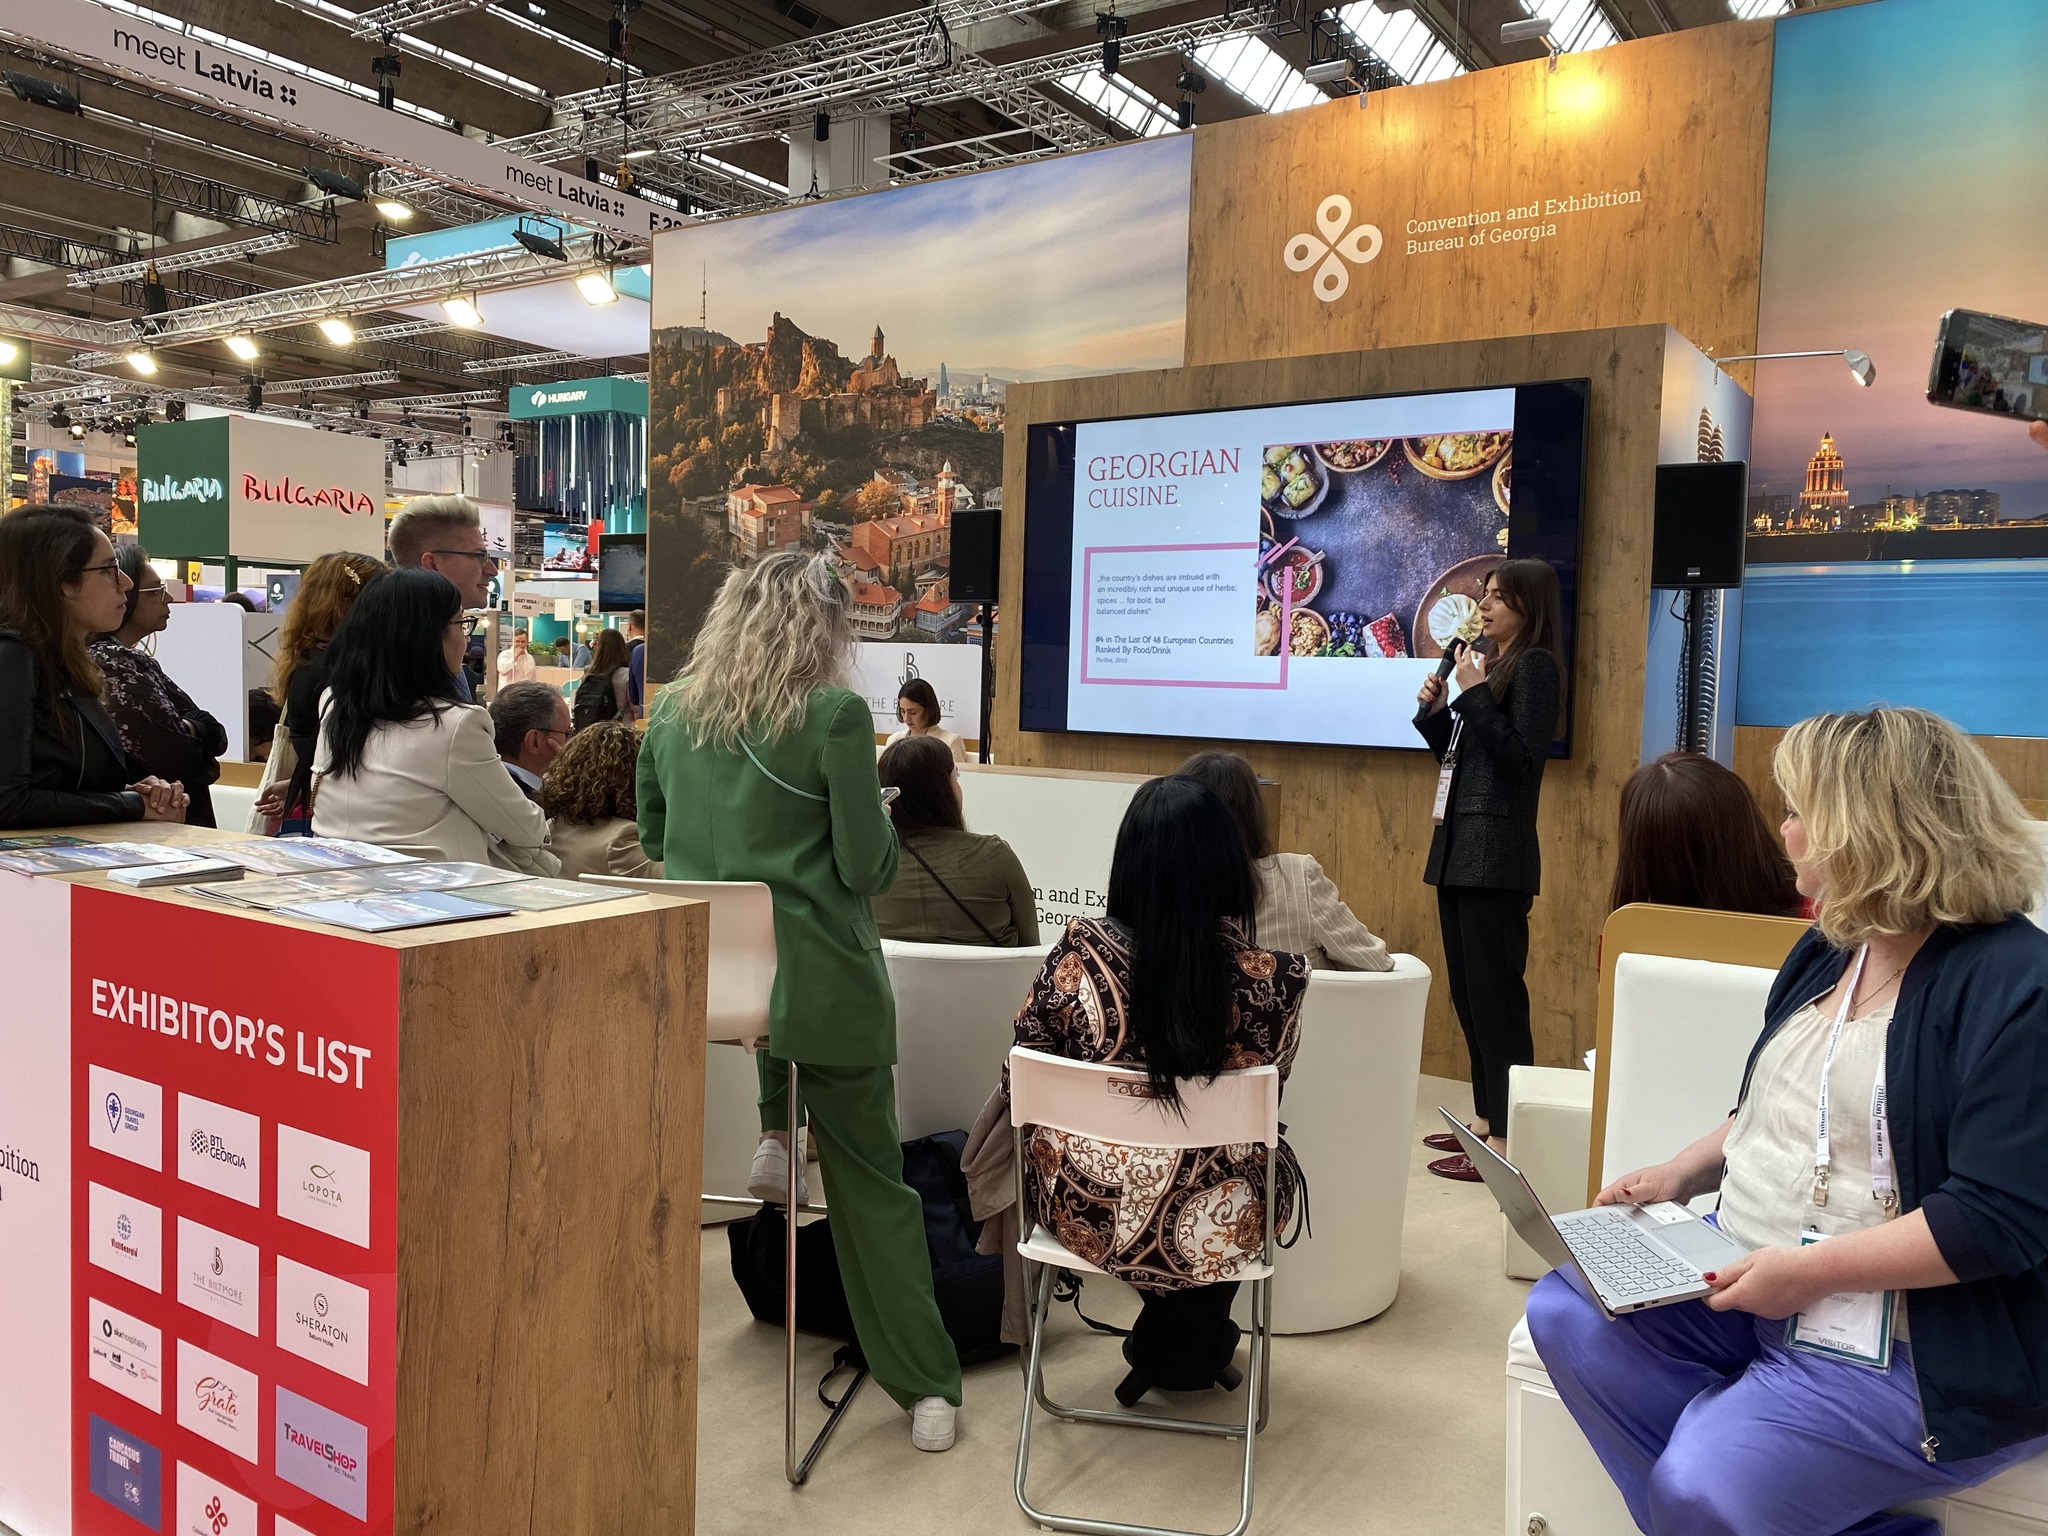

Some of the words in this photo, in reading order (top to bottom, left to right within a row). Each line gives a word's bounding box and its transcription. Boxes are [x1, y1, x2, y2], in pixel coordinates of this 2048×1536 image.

[113, 28, 186, 70] meet
[195, 50, 275, 100] Latvia
[506, 165, 553, 194] meet
[558, 177, 610, 213] Latvia
[1406, 208, 1502, 236] Convention
[1506, 201, 1540, 222] and
[1544, 188, 1642, 216] Exhibition
[1405, 235, 1465, 255] Bureau
[1469, 229, 1487, 246] of
[1489, 221, 1557, 246] Georgia
[548, 390, 587, 404] HUNGARY
[1088, 447, 1241, 482] GEORGIAN
[1088, 484, 1178, 508] CUISINE
[1142, 573, 1164, 582] dishes
[1178, 573, 1204, 581] imbued
[1205, 572, 1220, 580] with
[1107, 585, 1138, 594] incredibly
[1139, 585, 1152, 593] rich
[1153, 585, 1166, 593] and
[1167, 585, 1191, 594] unique
[1206, 584, 1214, 592] of
[1096, 598, 1118, 606] spices
[1137, 597, 1153, 605] bold,
[1096, 607, 1126, 615] balanced
[1095, 645, 1121, 654] Ranked
[1122, 645, 1132, 655] By
[1133, 645, 1172, 655] Food/Drink
[1105, 635, 1113, 643] in
[1114, 635, 1127, 643] The
[1128, 635, 1141, 644] List
[1142, 635, 1151, 644] Of
[1152, 636, 1162, 644] 48
[1163, 636, 1197, 646] European
[1198, 636, 1234, 645] Countries
[1048, 887, 1080, 905] and
[92, 977, 287, 1066] EXHIBITOR'S
[297, 1031, 371, 1090] LIST
[124, 1107, 145, 1119] GEORGIAN
[124, 1122, 139, 1132] GROUP
[210, 1134, 225, 1150] BTL
[210, 1146, 246, 1170] GEORGIA
[303, 1180, 343, 1203] LOPOTA
[192, 1272, 205, 1285] THE
[208, 1279, 243, 1302] BILTMORE
[296, 1312, 349, 1344] SHERATON
[322, 1338, 335, 1348] Hotel
[1818, 1336, 1856, 1353] VISITOR
[196, 1377, 240, 1416] Grata
[108, 1436, 140, 1464] CAUCASUS
[108, 1448, 130, 1470] TRAVEL
